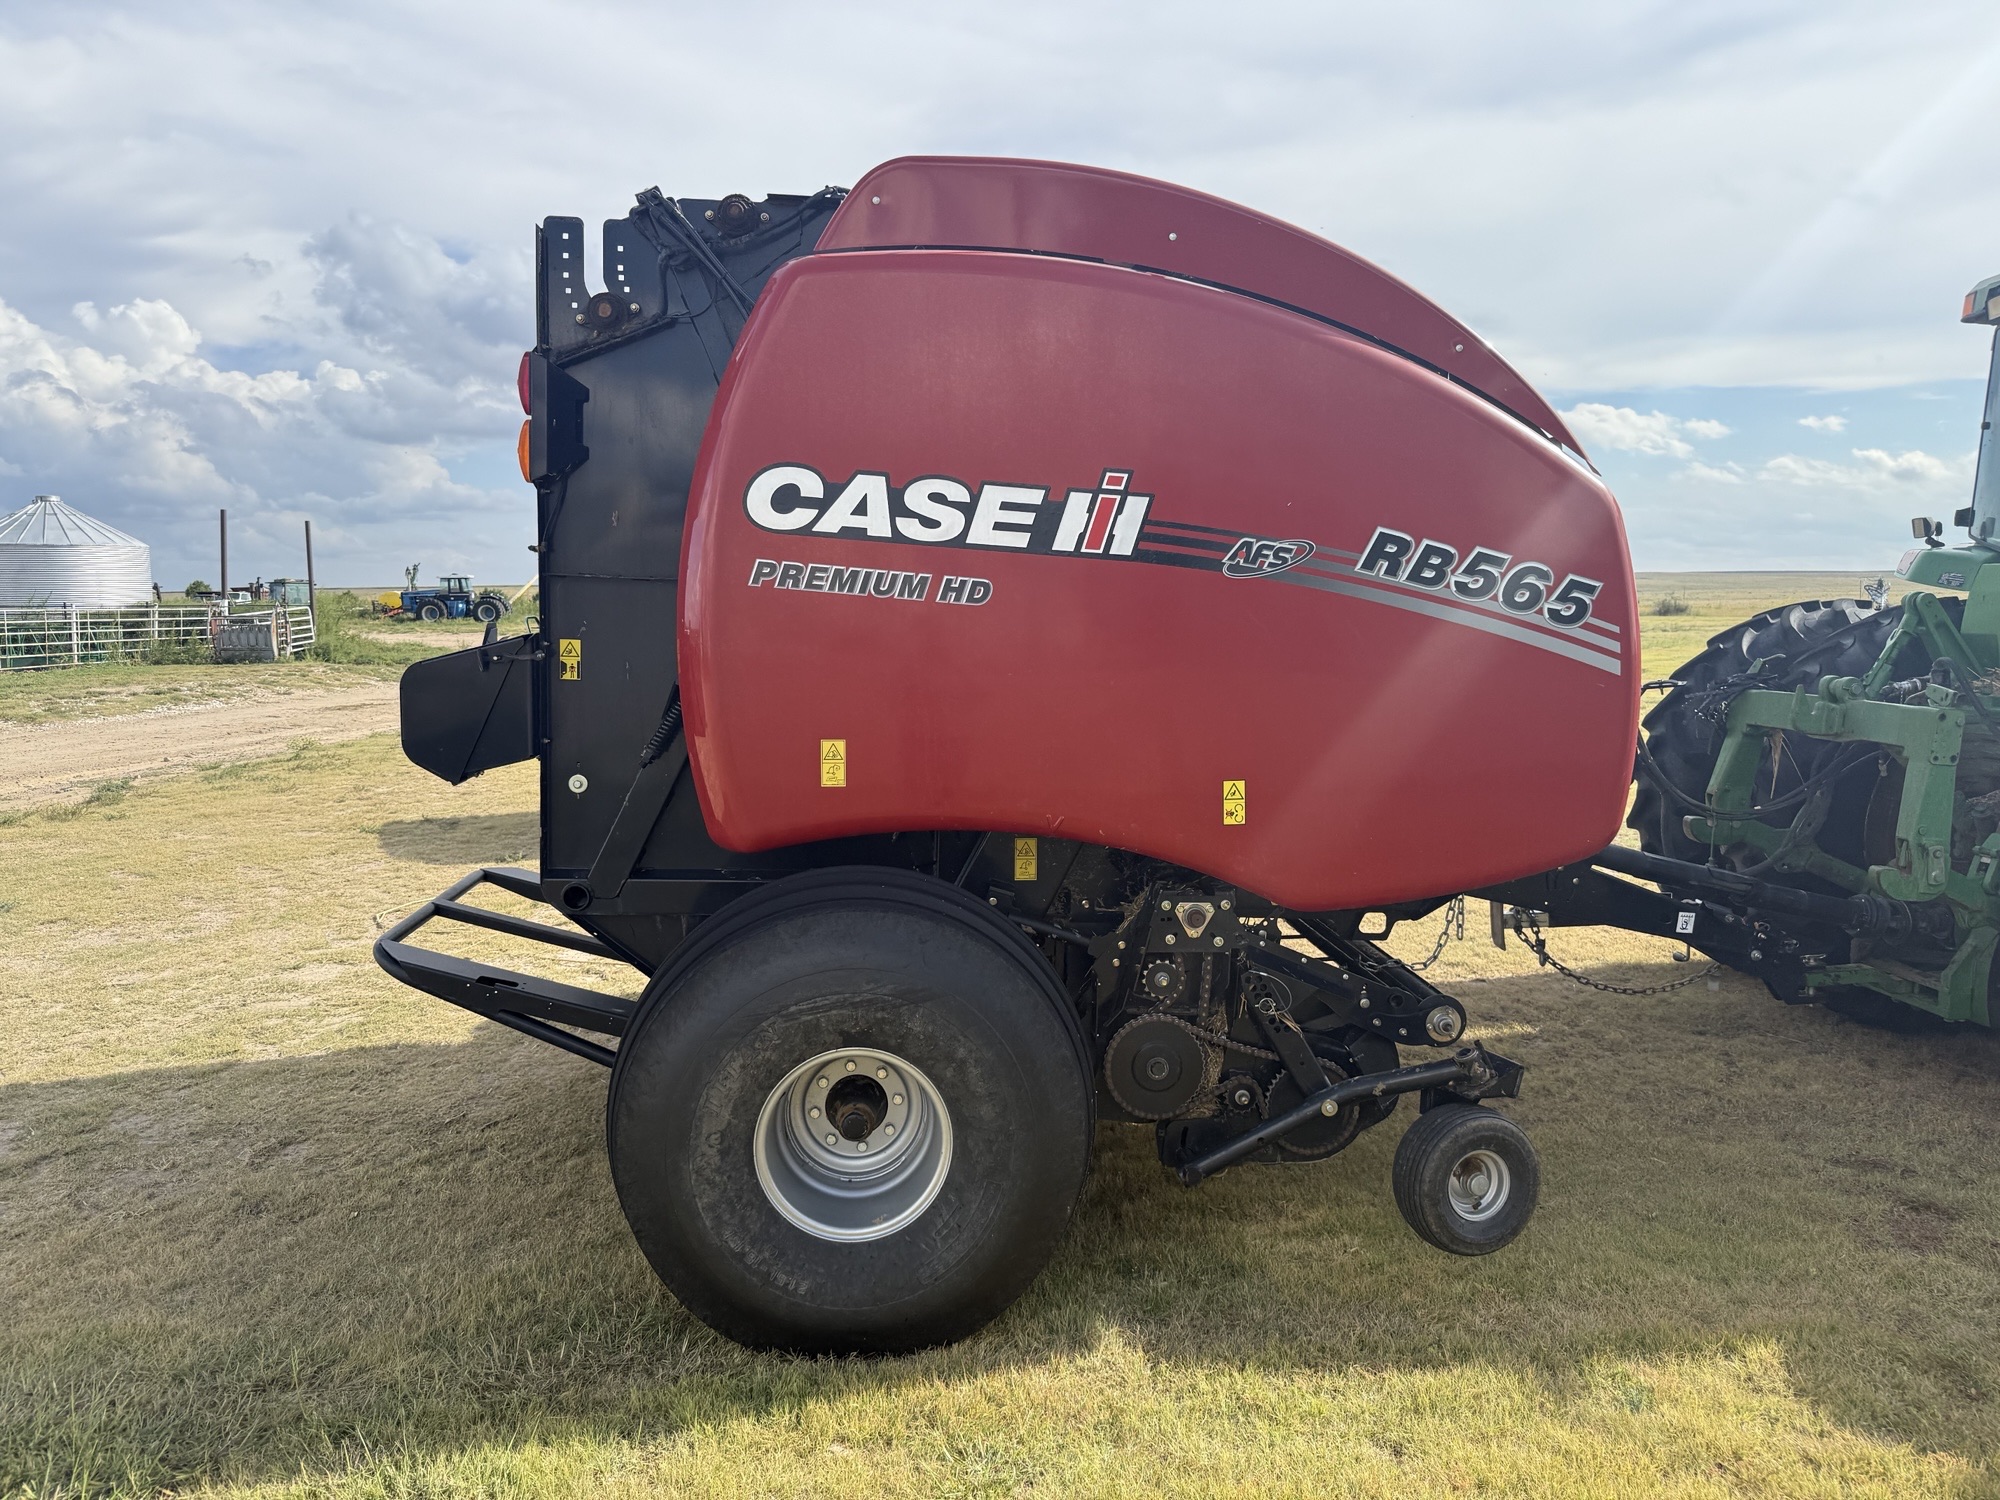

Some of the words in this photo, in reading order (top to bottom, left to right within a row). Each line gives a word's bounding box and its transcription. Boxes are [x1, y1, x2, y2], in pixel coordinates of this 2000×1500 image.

[744, 464, 1048, 550] CASE
[748, 559, 932, 601] PREMIUM
[937, 575, 993, 606] HD
[1223, 538, 1300, 569] AFS
[1355, 526, 1603, 628] RB565
